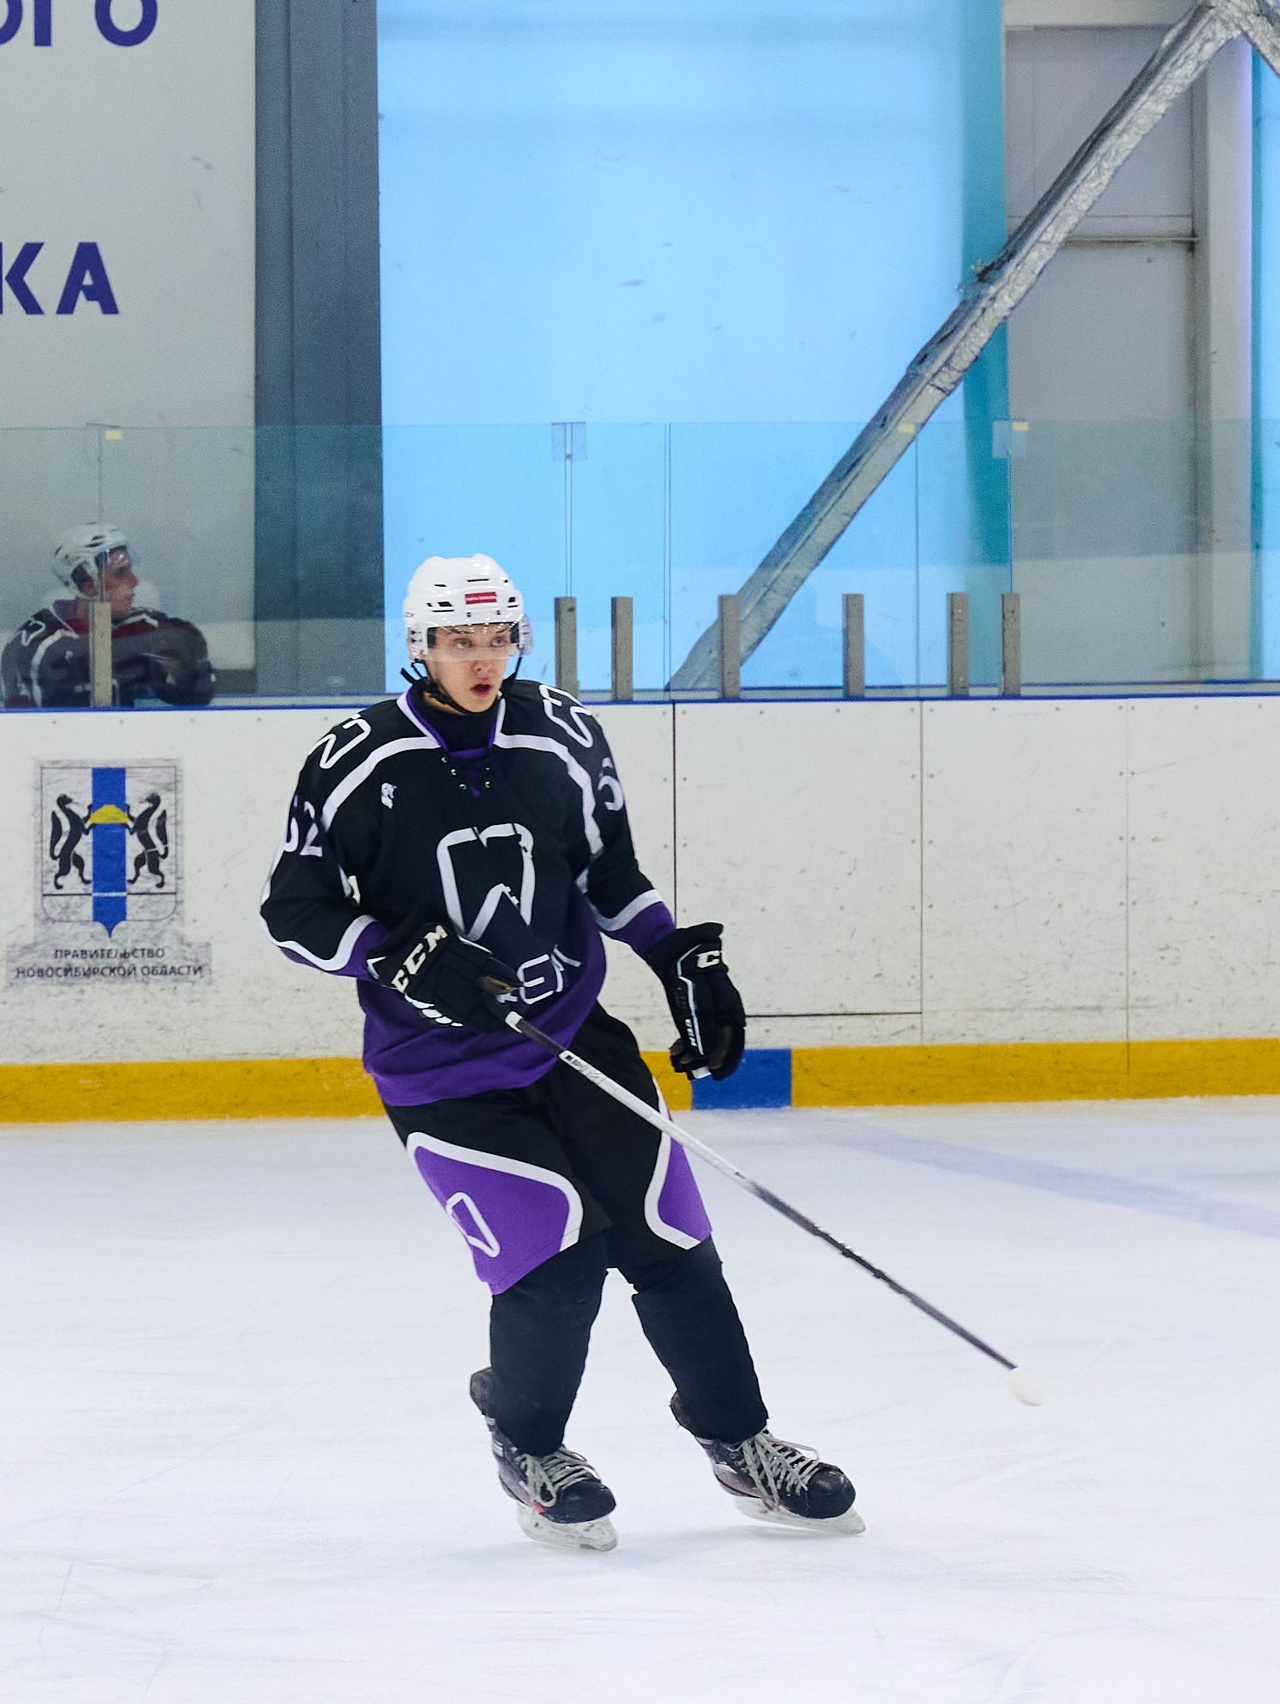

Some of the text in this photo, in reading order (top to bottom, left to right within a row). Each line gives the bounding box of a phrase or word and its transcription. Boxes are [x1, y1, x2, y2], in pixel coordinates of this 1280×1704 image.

[54, 948, 165, 959] ПРАВИТЕЛЬСТВО
[391, 924, 448, 993] CCM
[141, 965, 203, 977] ОБЛАСТИ
